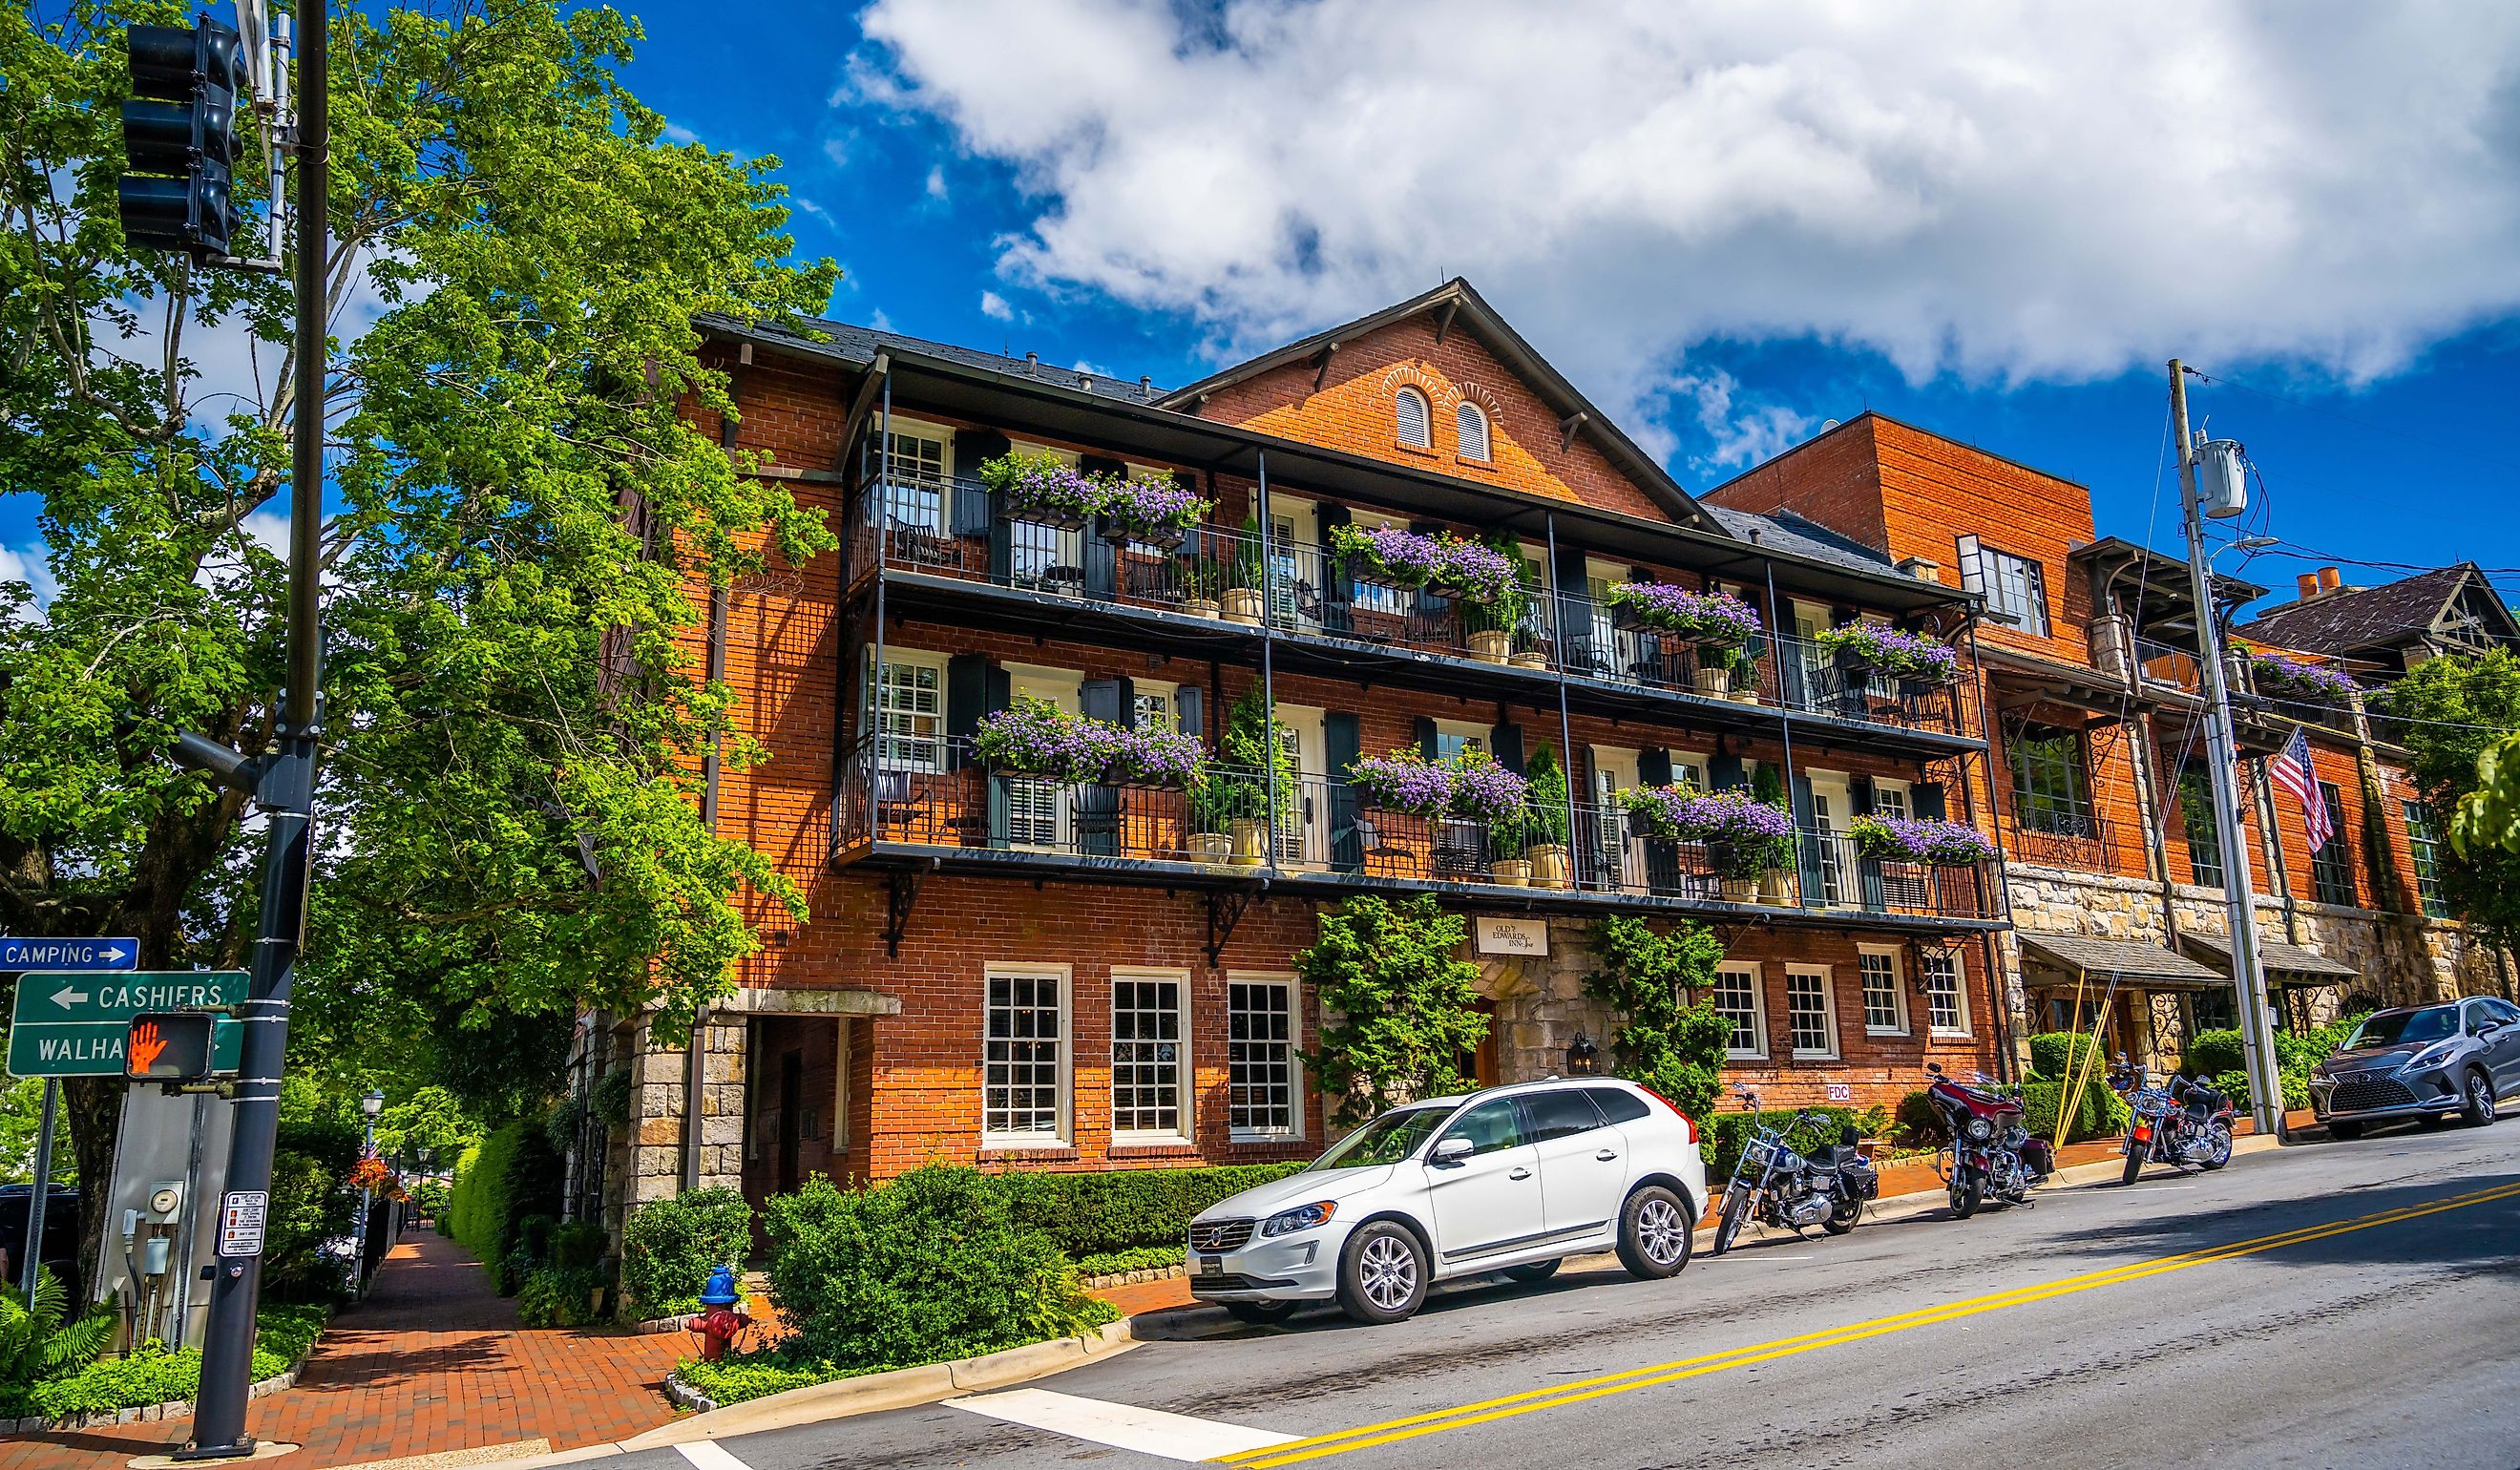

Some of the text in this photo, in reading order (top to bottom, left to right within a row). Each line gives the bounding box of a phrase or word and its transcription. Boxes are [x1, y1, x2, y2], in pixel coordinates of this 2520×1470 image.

[1492, 932, 1526, 940] EDWARDS
[6, 946, 94, 963] CAMPING
[98, 985, 222, 1008] CASHIERS
[39, 1038, 124, 1060] WALHA
[1829, 1086, 1847, 1098] FDC
